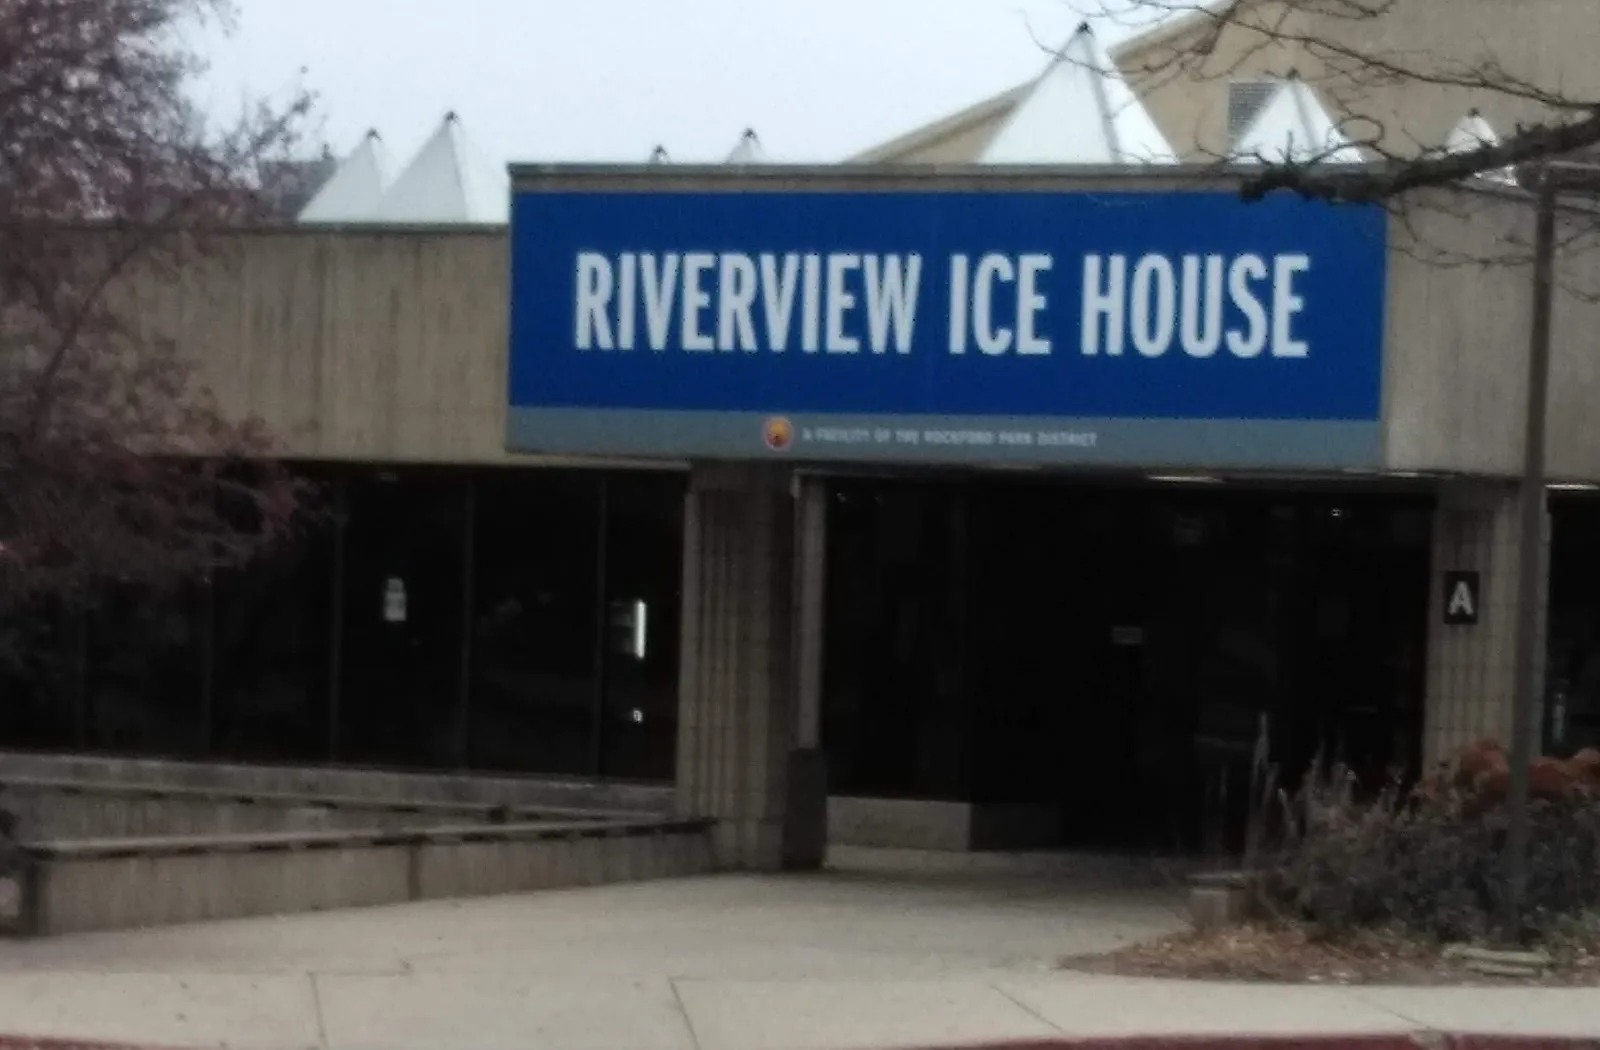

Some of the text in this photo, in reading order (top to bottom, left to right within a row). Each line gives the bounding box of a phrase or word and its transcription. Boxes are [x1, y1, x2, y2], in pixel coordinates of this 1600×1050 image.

[575, 252, 1310, 359] RIVERVIEW ICE HOUSE
[896, 430, 919, 446] THE
[1037, 432, 1098, 448] DISTRICT
[1448, 580, 1474, 615] A
